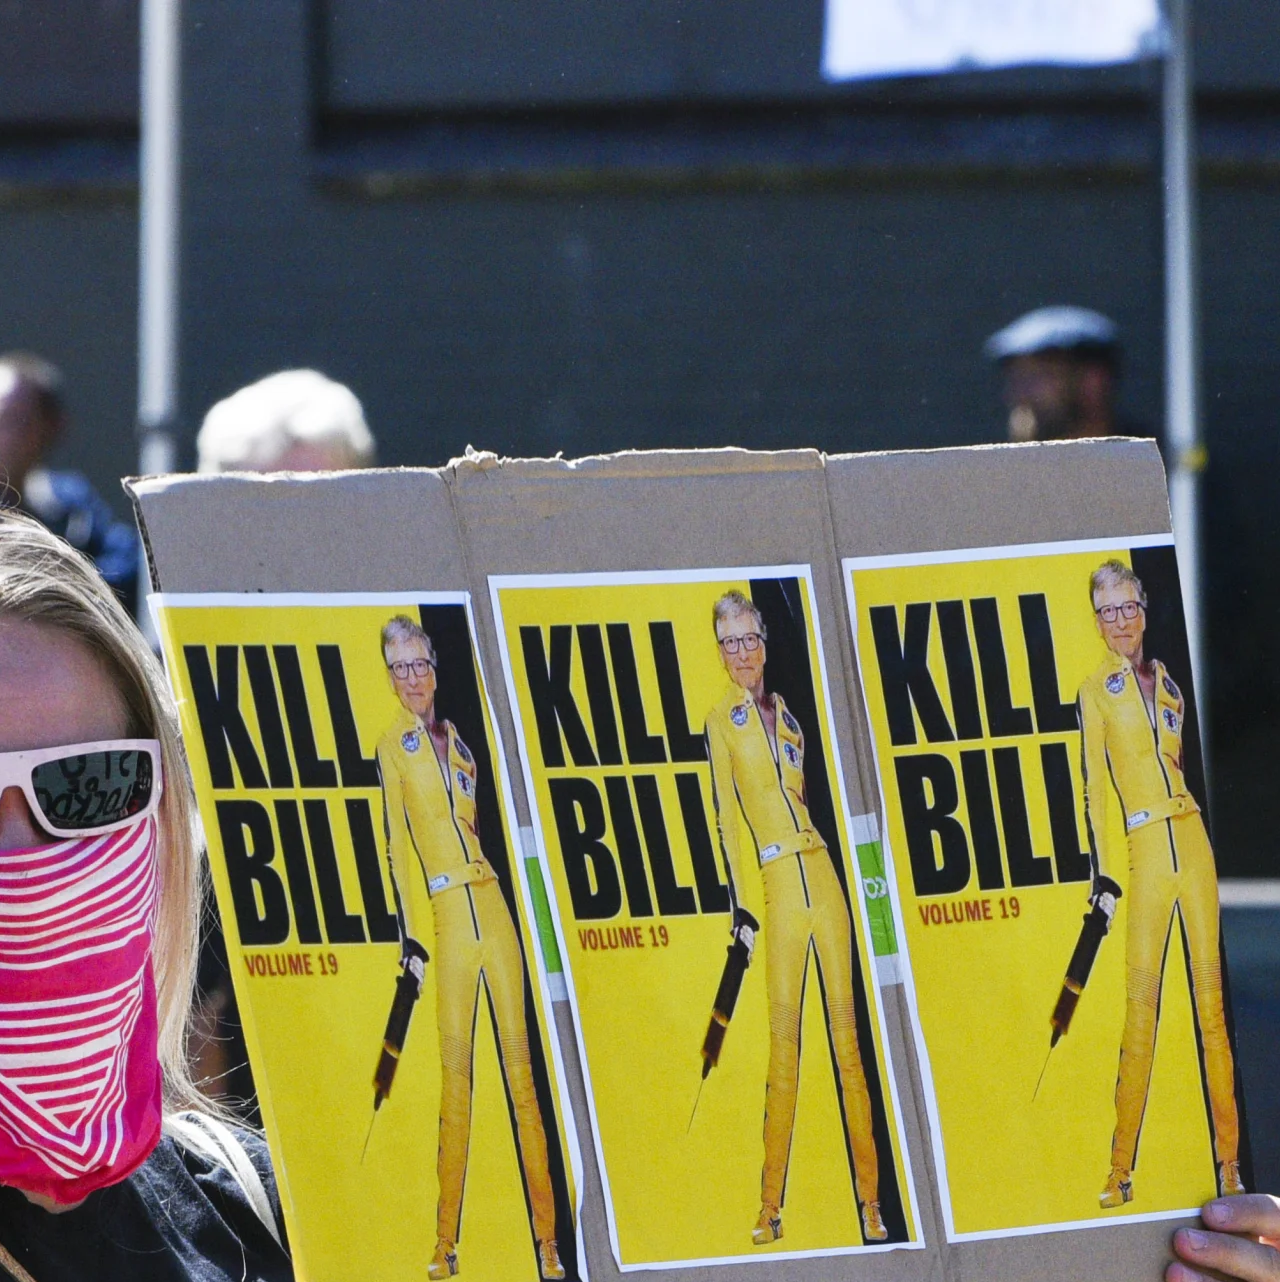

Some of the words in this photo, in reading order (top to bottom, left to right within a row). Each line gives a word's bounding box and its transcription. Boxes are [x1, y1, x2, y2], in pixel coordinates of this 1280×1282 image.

[183, 644, 379, 790] KILL
[519, 620, 709, 768] KILL
[869, 593, 1080, 747] KILL
[215, 798, 400, 946] BILL
[548, 772, 731, 921] BILL
[894, 743, 1091, 898] BILL
[244, 955, 313, 977] VOLUME
[317, 953, 339, 975] 19
[578, 928, 644, 951] VOLUME
[648, 926, 669, 947] 19
[918, 900, 994, 926] VOLUME
[999, 896, 1021, 919] 19
